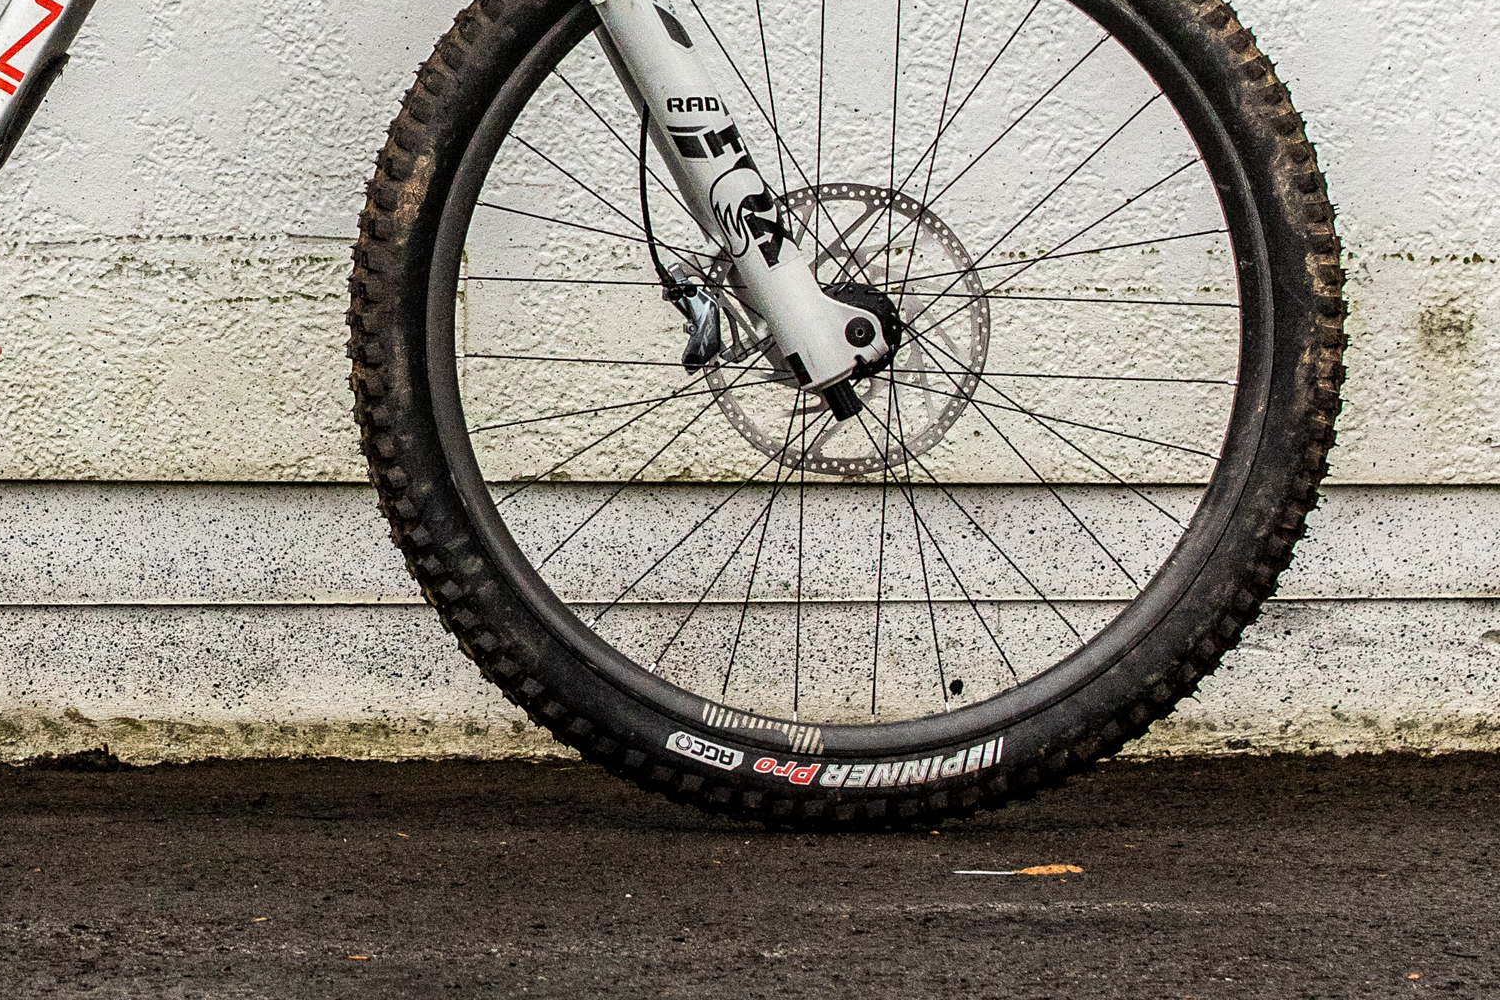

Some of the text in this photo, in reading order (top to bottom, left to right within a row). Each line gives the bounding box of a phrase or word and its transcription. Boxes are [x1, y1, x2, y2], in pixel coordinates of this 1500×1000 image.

[667, 96, 720, 113] RAD
[753, 756, 821, 786] Pro
[819, 750, 966, 787] PINNER
